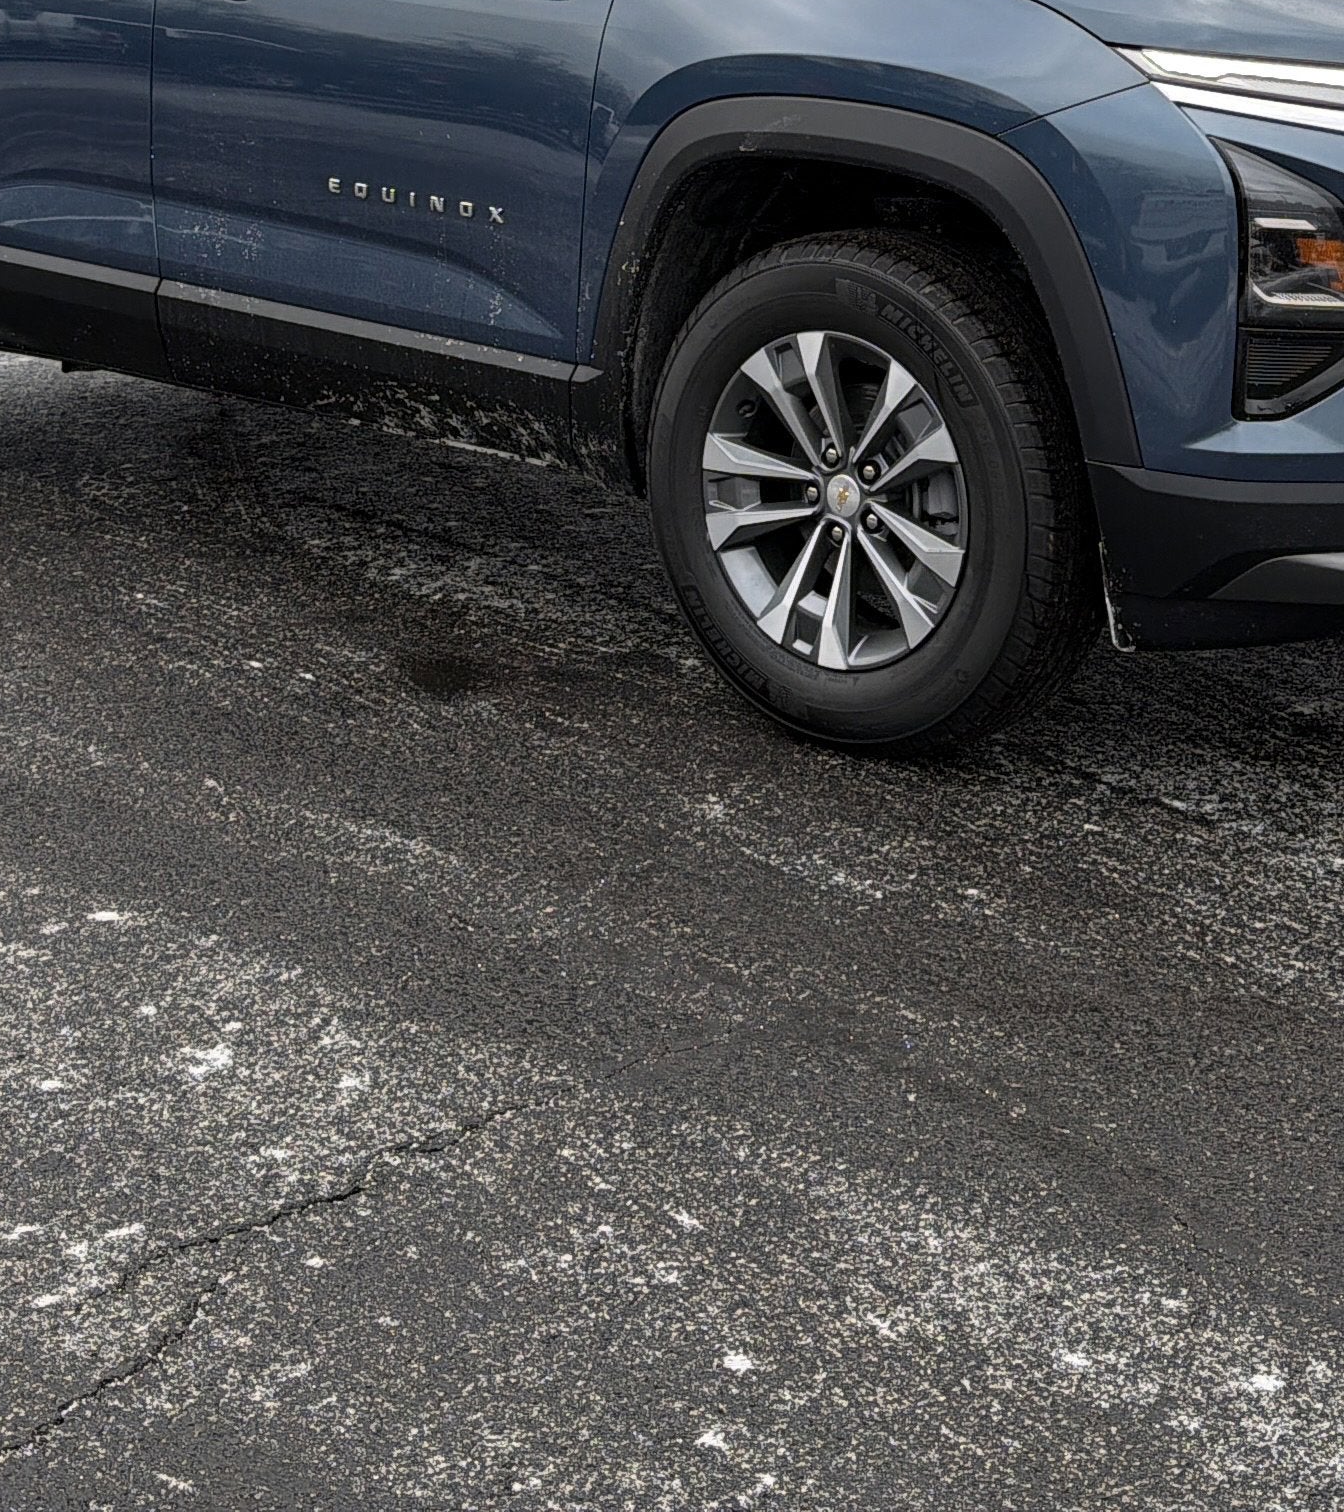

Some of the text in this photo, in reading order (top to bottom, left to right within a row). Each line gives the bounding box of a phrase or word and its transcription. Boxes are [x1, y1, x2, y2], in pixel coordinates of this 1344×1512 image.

[328, 177, 505, 224] EQUINOX
[880, 304, 974, 405] MICHELIN
[684, 588, 765, 690] MICHELIN
